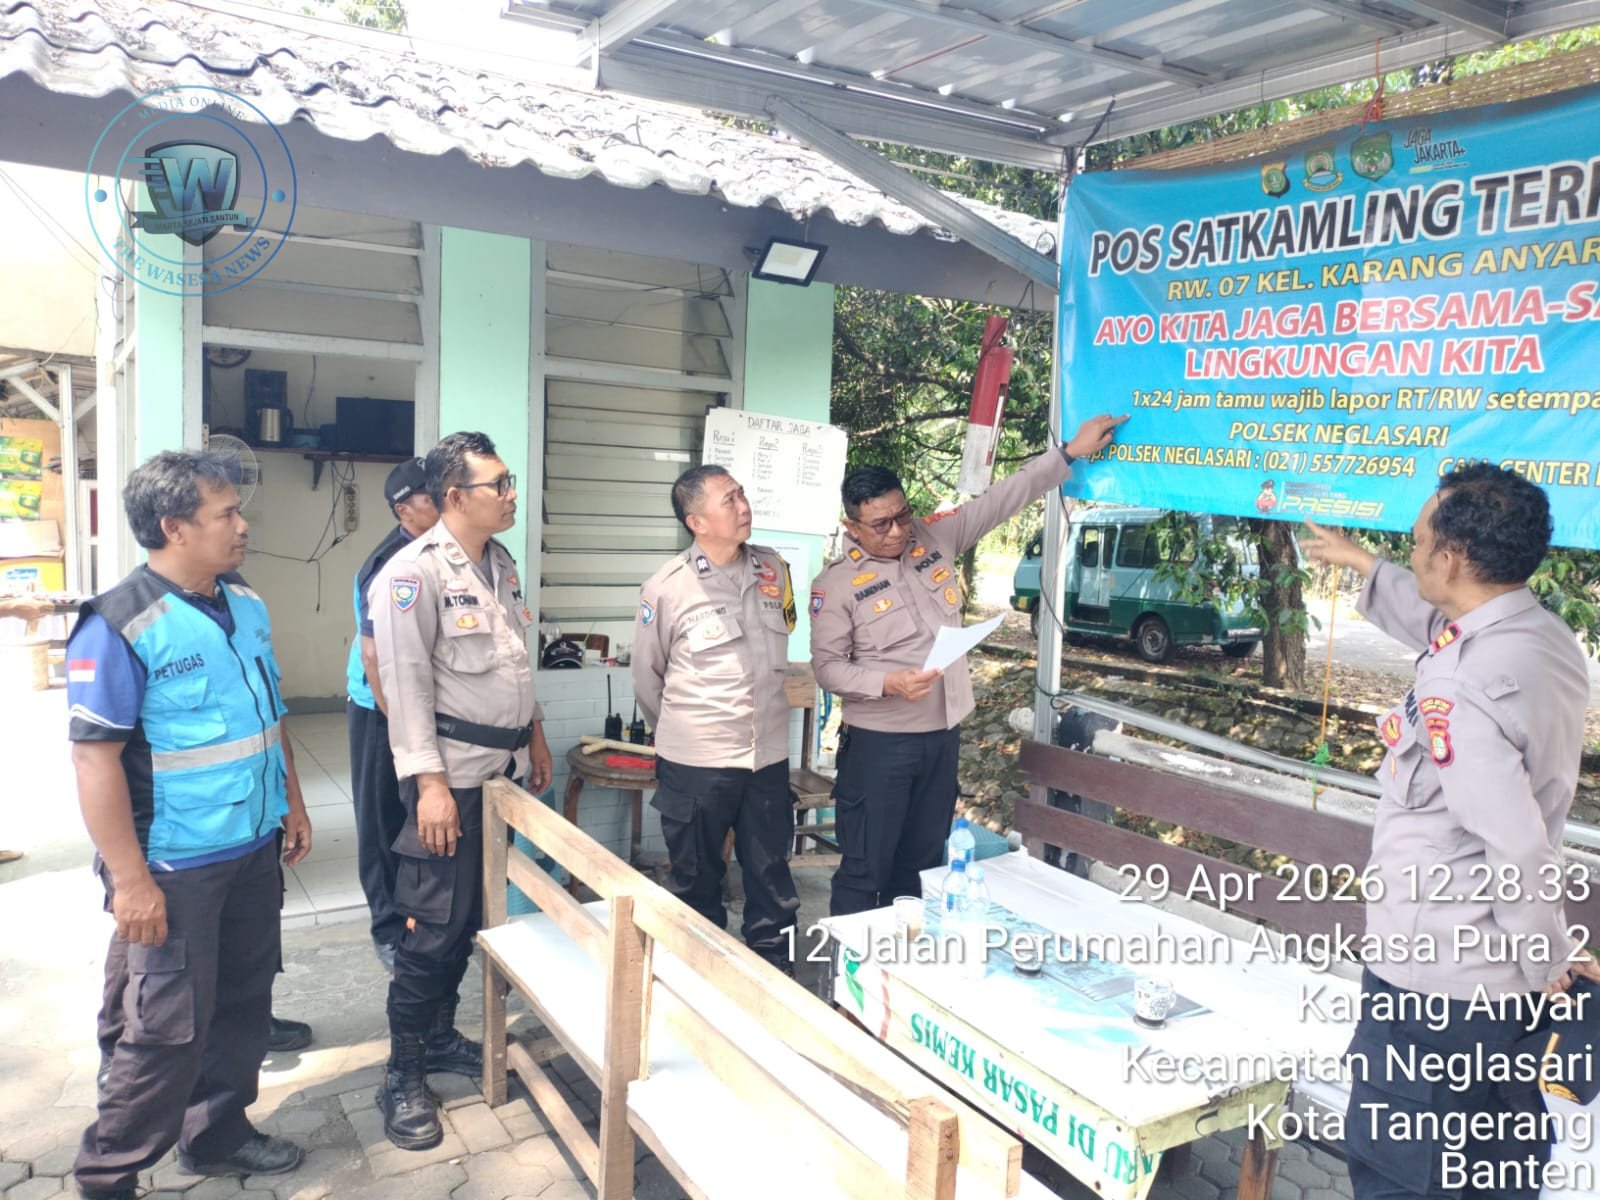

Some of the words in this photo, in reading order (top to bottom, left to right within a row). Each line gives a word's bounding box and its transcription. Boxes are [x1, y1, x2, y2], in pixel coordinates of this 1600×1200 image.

[1088, 228, 1162, 278] POS
[1165, 179, 1464, 273] SATKAMLING
[1167, 277, 1212, 302] RW.
[1221, 276, 1249, 298] 07
[1257, 268, 1314, 295] KEL.
[1321, 252, 1464, 287] KARANG
[1094, 314, 1154, 346] AYO
[1159, 308, 1229, 341] KITA
[1233, 301, 1326, 340] JAGA
[1333, 281, 1600, 334] BERSAMA-S
[1184, 338, 1432, 380] LINGKUNGAN
[1438, 333, 1546, 376] KITA
[1131, 389, 1173, 409] 1x24
[1171, 389, 1211, 413] jam
[1215, 390, 1266, 411] tamu
[1271, 388, 1325, 415] wajib
[1330, 388, 1389, 416] lapor
[1396, 386, 1483, 411] RT/RW
[1229, 420, 1312, 445] POLSEK
[1314, 423, 1450, 449] NEGLASARI
[1108, 444, 1161, 464] POLSEK
[1163, 446, 1252, 469] NEGLASARI
[1262, 450, 1306, 475] (021)
[1310, 452, 1415, 478] 557726954
[914, 550, 943, 573] POLRI
[154, 653, 205, 681] PETUGAS
[910, 1012, 977, 1081] KEMIS
[982, 1058, 1059, 1137] PASAR
[1068, 1114, 1096, 1162] DI
